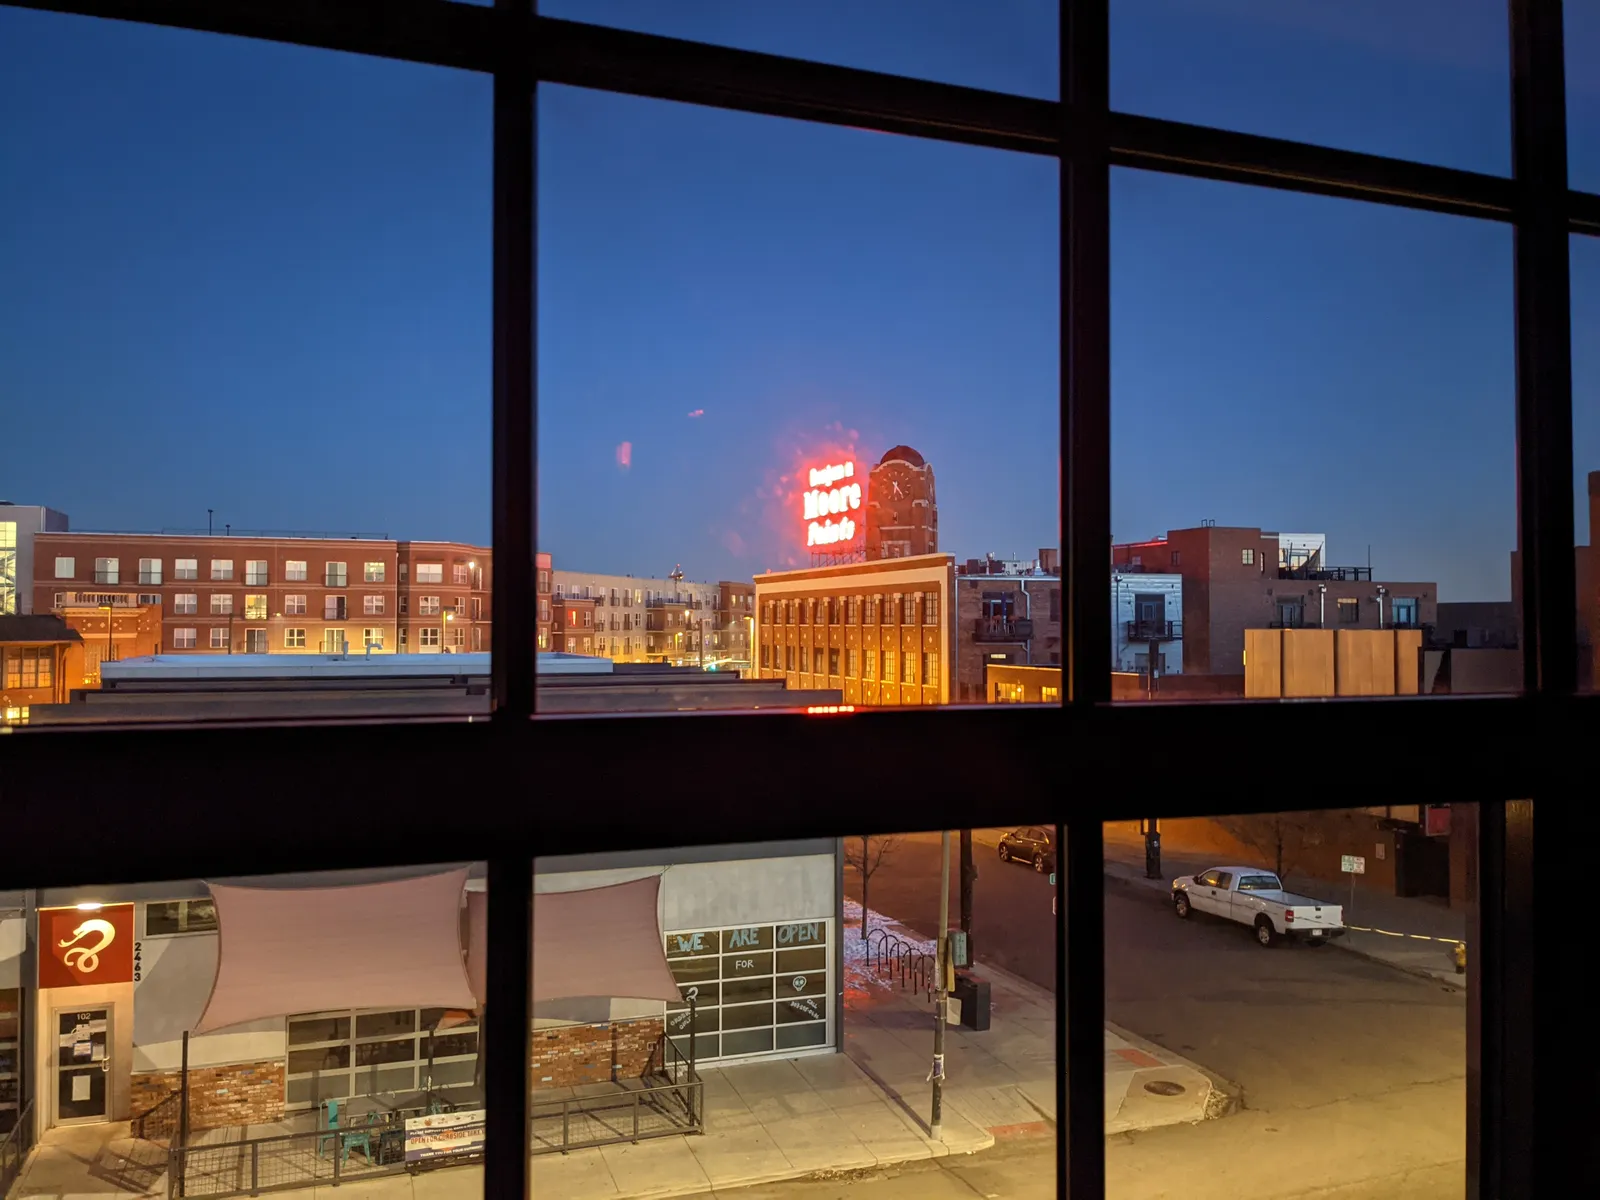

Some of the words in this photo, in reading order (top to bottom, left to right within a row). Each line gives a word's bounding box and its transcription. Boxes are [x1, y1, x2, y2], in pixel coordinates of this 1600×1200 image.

[677, 932, 705, 952] WE
[729, 927, 760, 949] ARE
[777, 922, 819, 943] OPEN
[134, 942, 142, 982] 2463
[735, 960, 754, 970] FOR
[410, 1137, 426, 1145] OPEN
[426, 1135, 437, 1143] FOR
